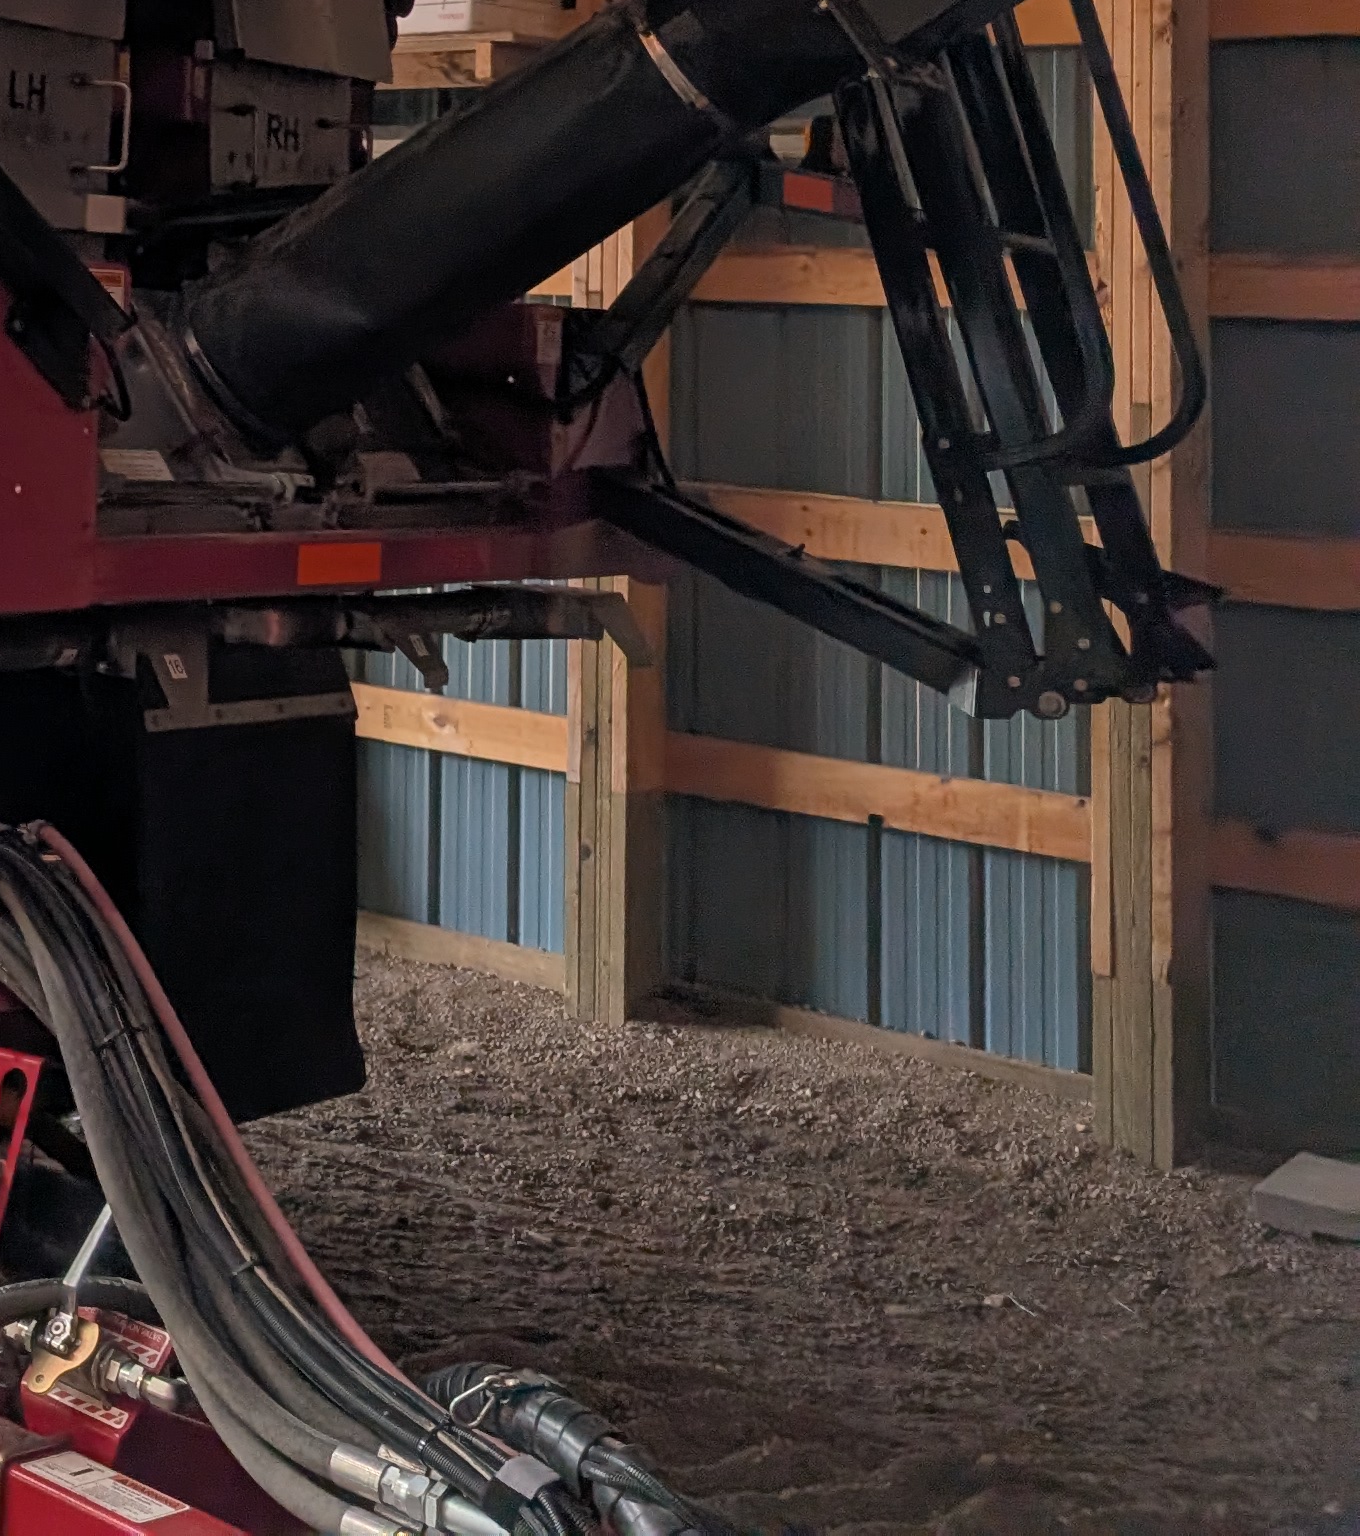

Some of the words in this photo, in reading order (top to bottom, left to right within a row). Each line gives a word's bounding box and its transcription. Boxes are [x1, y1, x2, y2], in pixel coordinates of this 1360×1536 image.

[8, 70, 46, 113] LH
[266, 112, 300, 152] RH
[168, 659, 184, 675] 16
